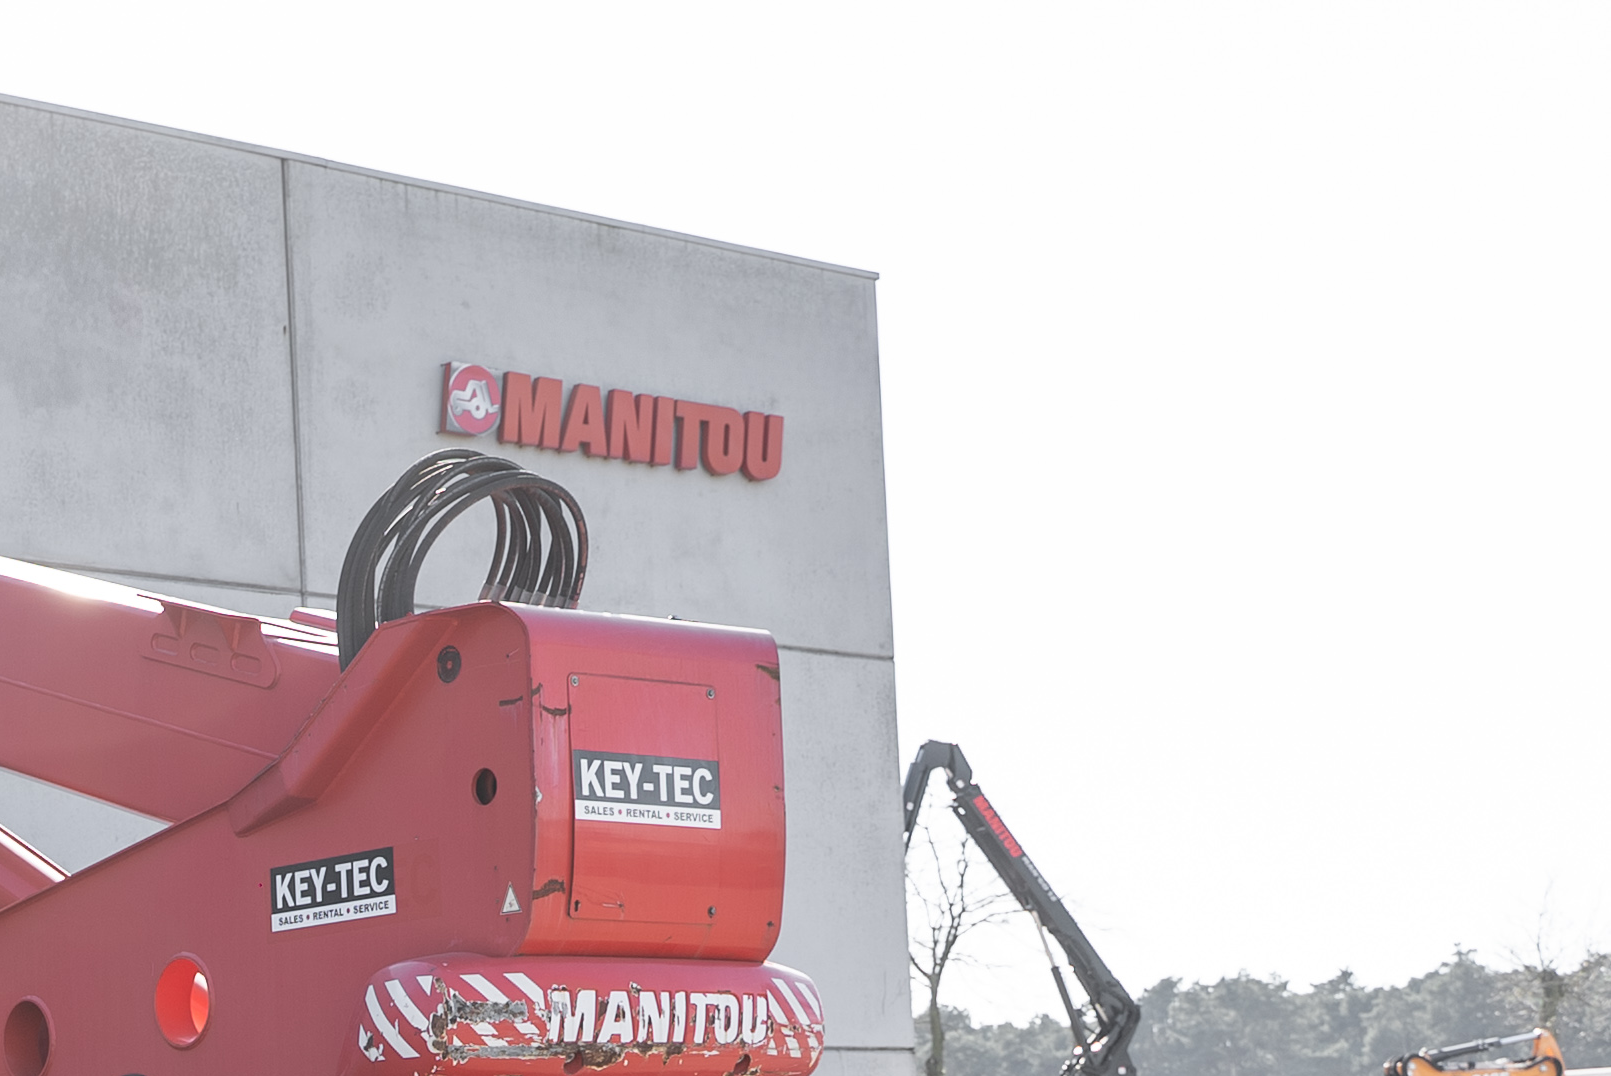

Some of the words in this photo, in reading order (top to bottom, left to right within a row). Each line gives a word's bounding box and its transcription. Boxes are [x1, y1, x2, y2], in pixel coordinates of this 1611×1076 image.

[497, 371, 785, 482] MANITOU
[580, 758, 714, 805] KEY-TEC
[584, 805, 615, 816] SALES
[626, 808, 663, 820] RENTAL
[673, 811, 714, 823] SERVICE
[275, 856, 390, 909] KEY-TEC
[278, 914, 304, 926] SALES
[312, 907, 344, 921] RENTAL
[353, 900, 390, 914] SERVICE
[547, 989, 768, 1045] MANITOU
